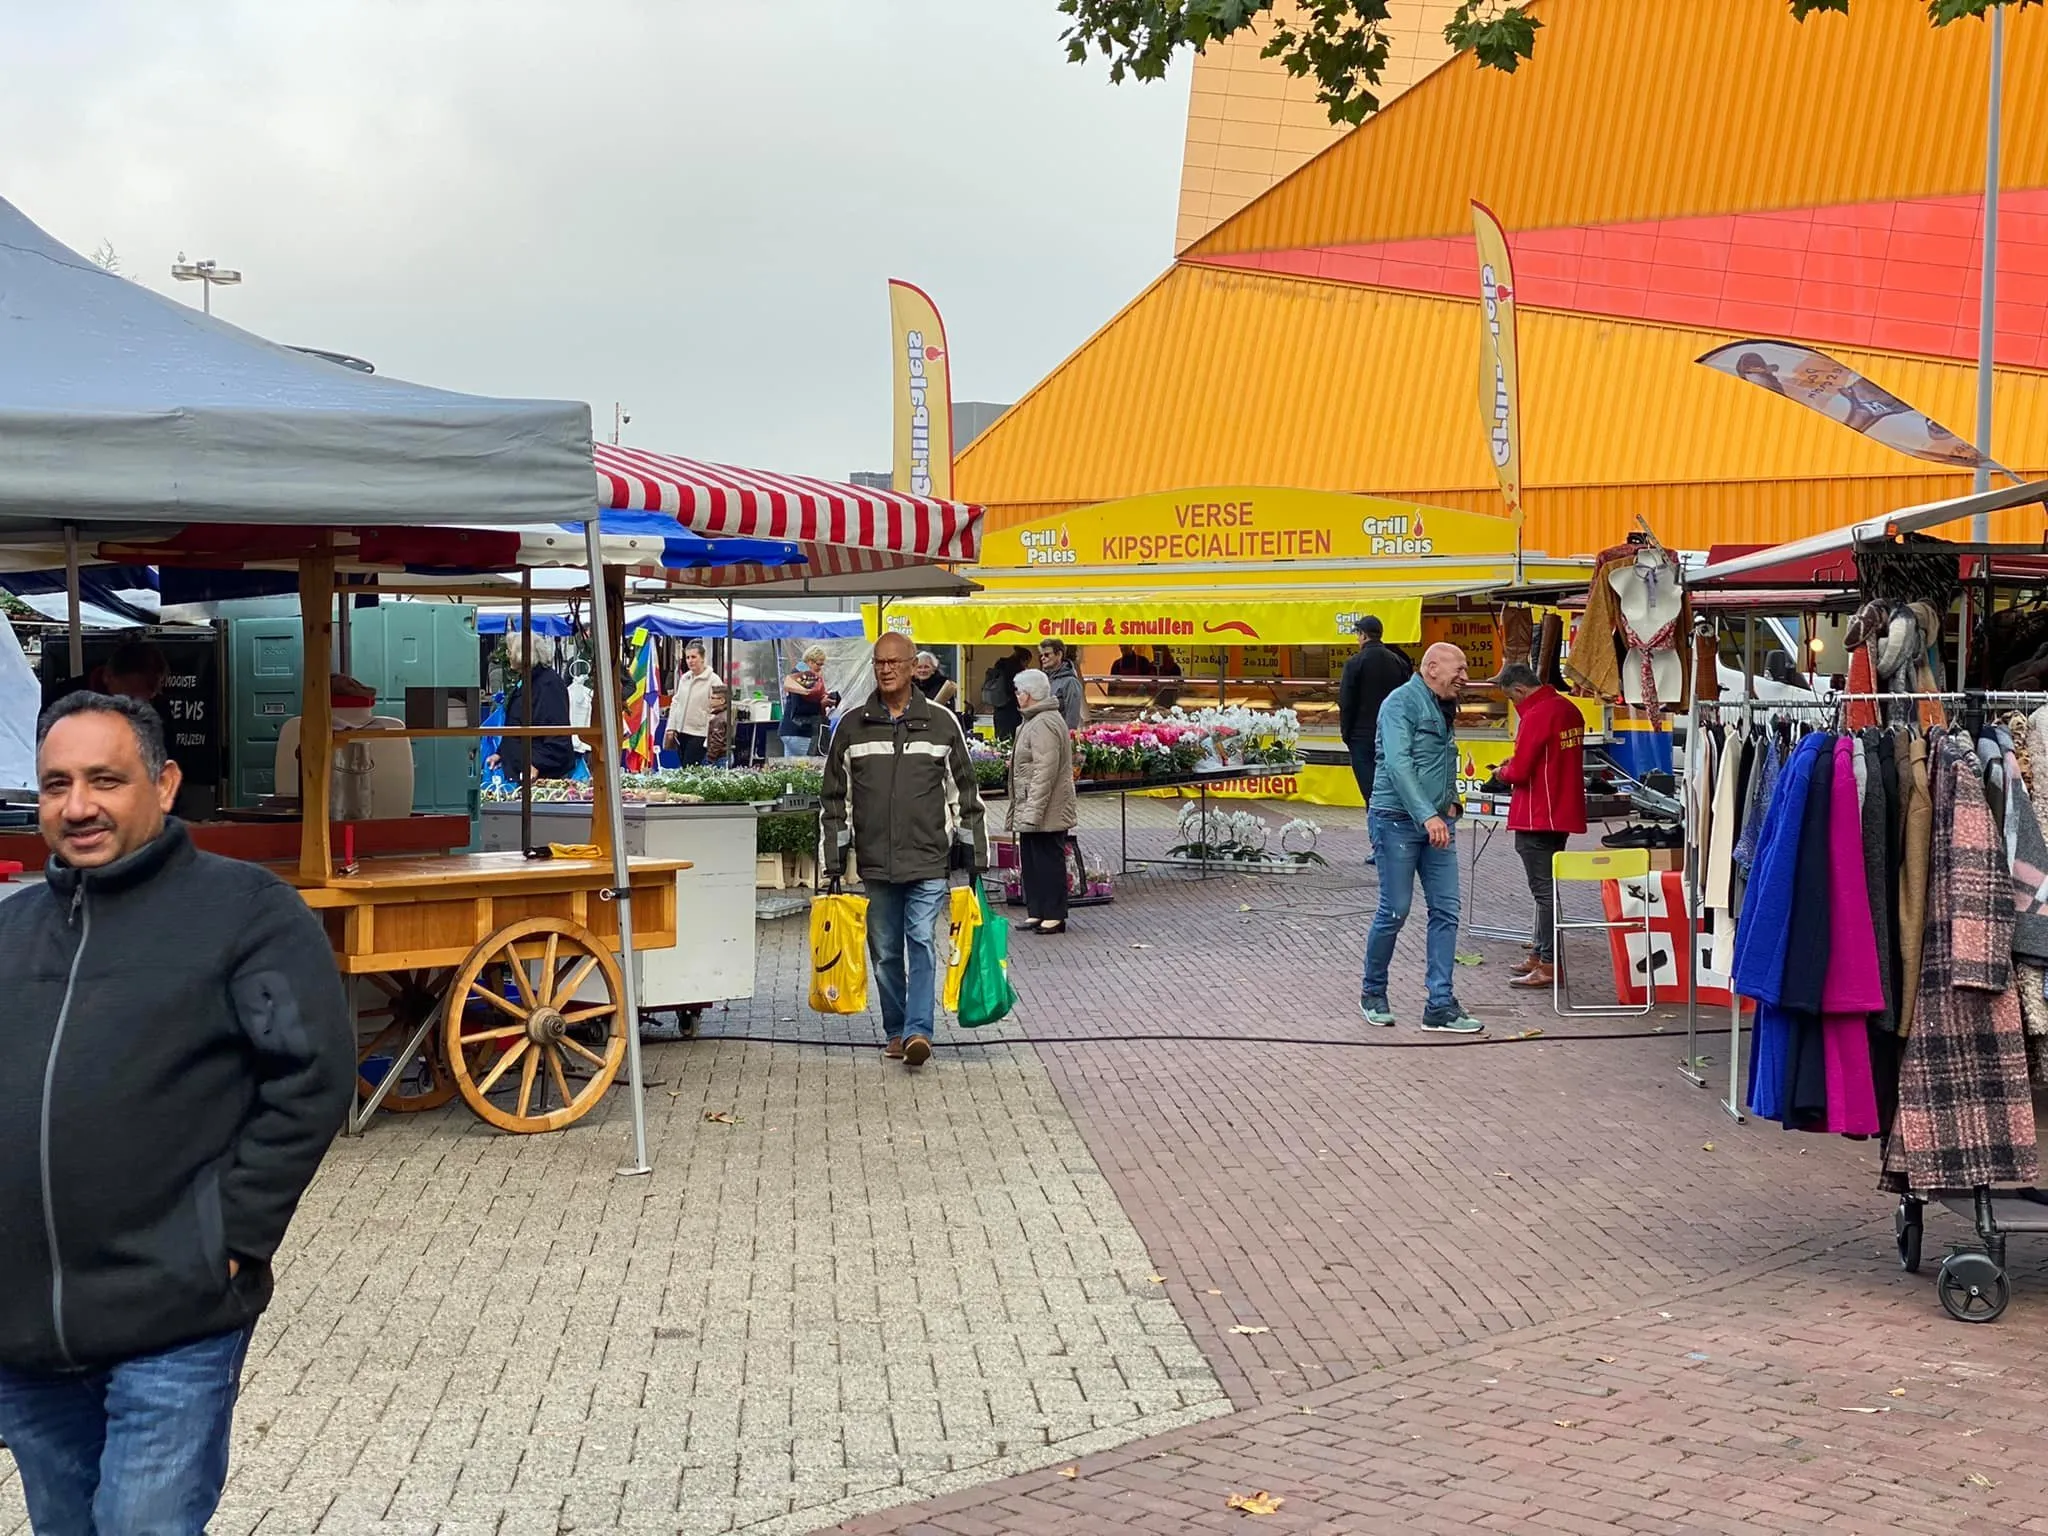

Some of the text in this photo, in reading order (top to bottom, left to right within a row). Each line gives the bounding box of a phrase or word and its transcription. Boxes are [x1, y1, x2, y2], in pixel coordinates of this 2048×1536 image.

[1175, 502, 1253, 528] VERSE
[1363, 516, 1408, 535] Grill
[1020, 530, 1057, 547] Grill
[1102, 529, 1331, 560] KIPSPECIALITEITEN
[1370, 536, 1432, 555] Paleis
[1027, 547, 1076, 564] Paleis
[1038, 617, 1194, 636] Grillen & smullen
[1471, 640, 1493, 651] 5,95
[185, 700, 205, 721] VIS
